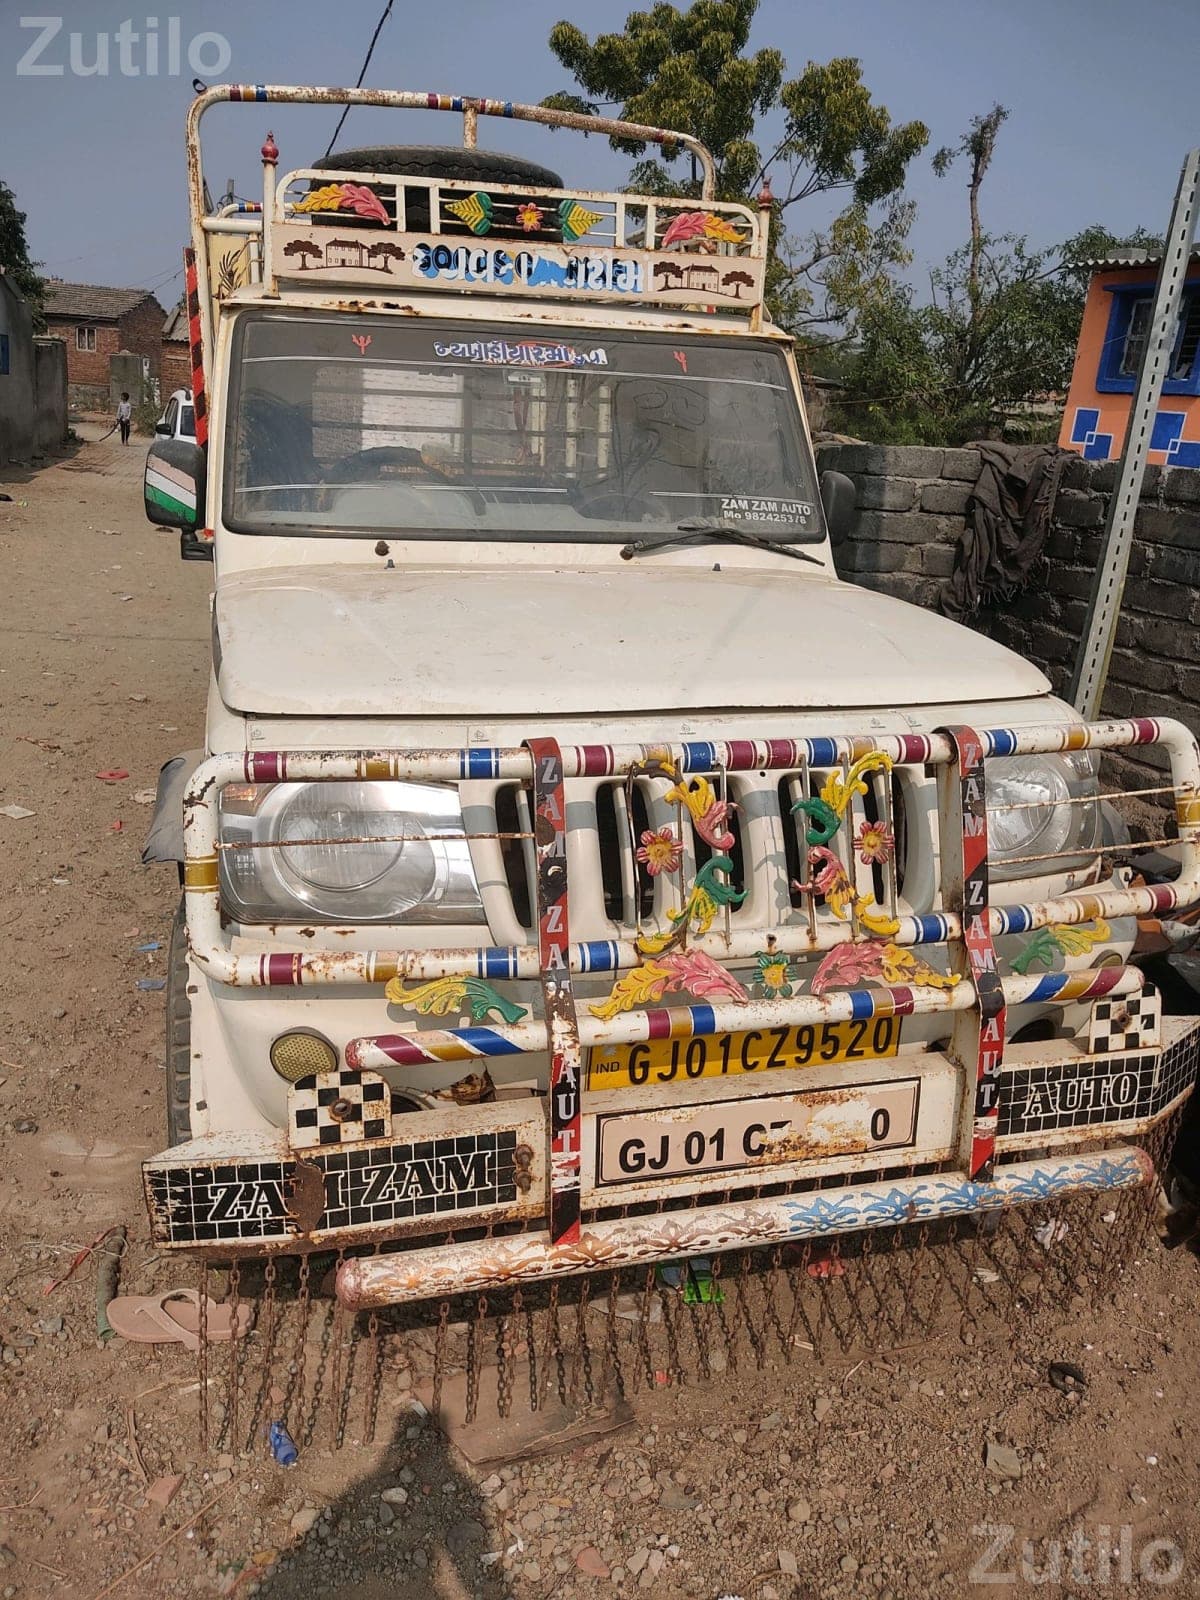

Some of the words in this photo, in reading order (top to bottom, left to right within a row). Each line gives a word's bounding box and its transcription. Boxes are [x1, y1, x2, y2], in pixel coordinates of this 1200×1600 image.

[721, 498, 748, 510] ZAM
[751, 500, 778, 512] ZAM
[781, 503, 811, 515] AUTO
[723, 510, 742, 519] Mo
[969, 880, 995, 974] ZAM
[595, 1060, 621, 1075] IND
[628, 1017, 894, 1086] GJ01CZ9520
[1022, 1071, 1140, 1119] AUTO
[619, 1137, 670, 1173] GJ
[684, 1127, 726, 1166] 01
[361, 1151, 493, 1206] ZAM
